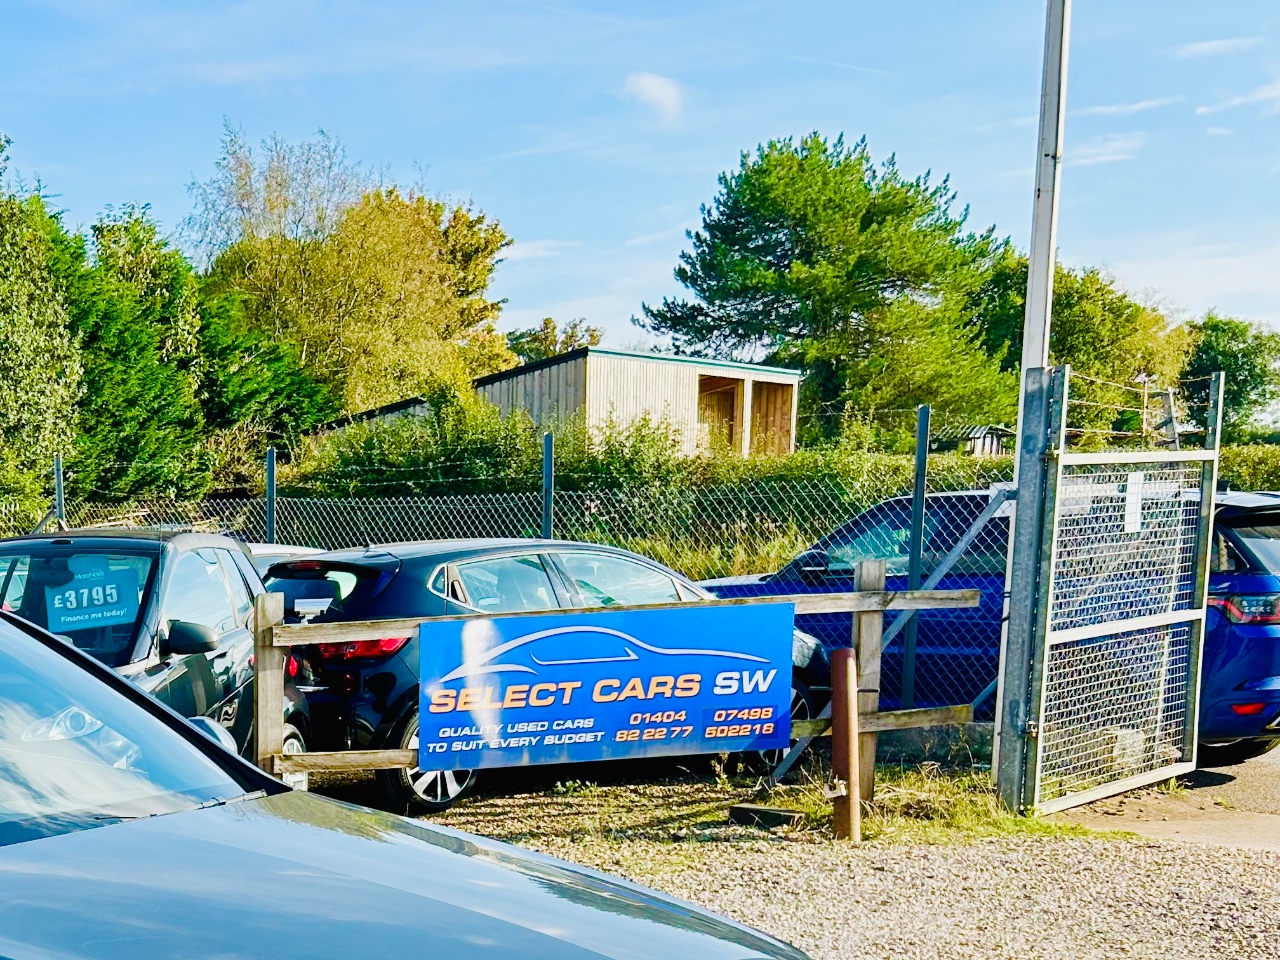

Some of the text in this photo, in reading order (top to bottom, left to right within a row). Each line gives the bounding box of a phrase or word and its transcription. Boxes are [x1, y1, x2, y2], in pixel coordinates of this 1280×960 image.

[53, 584, 118, 609] £3795
[61, 614, 89, 623] Finance
[103, 608, 127, 618] today!
[429, 668, 778, 713] SELECT CARS SW
[629, 710, 687, 725] 01404
[713, 707, 773, 722] 07498
[438, 718, 594, 738] QUALITY USED CARS
[615, 725, 694, 742] 82 22 77
[704, 722, 775, 739] 502218
[427, 731, 606, 753] TO SUIT EVERY BUDGET
